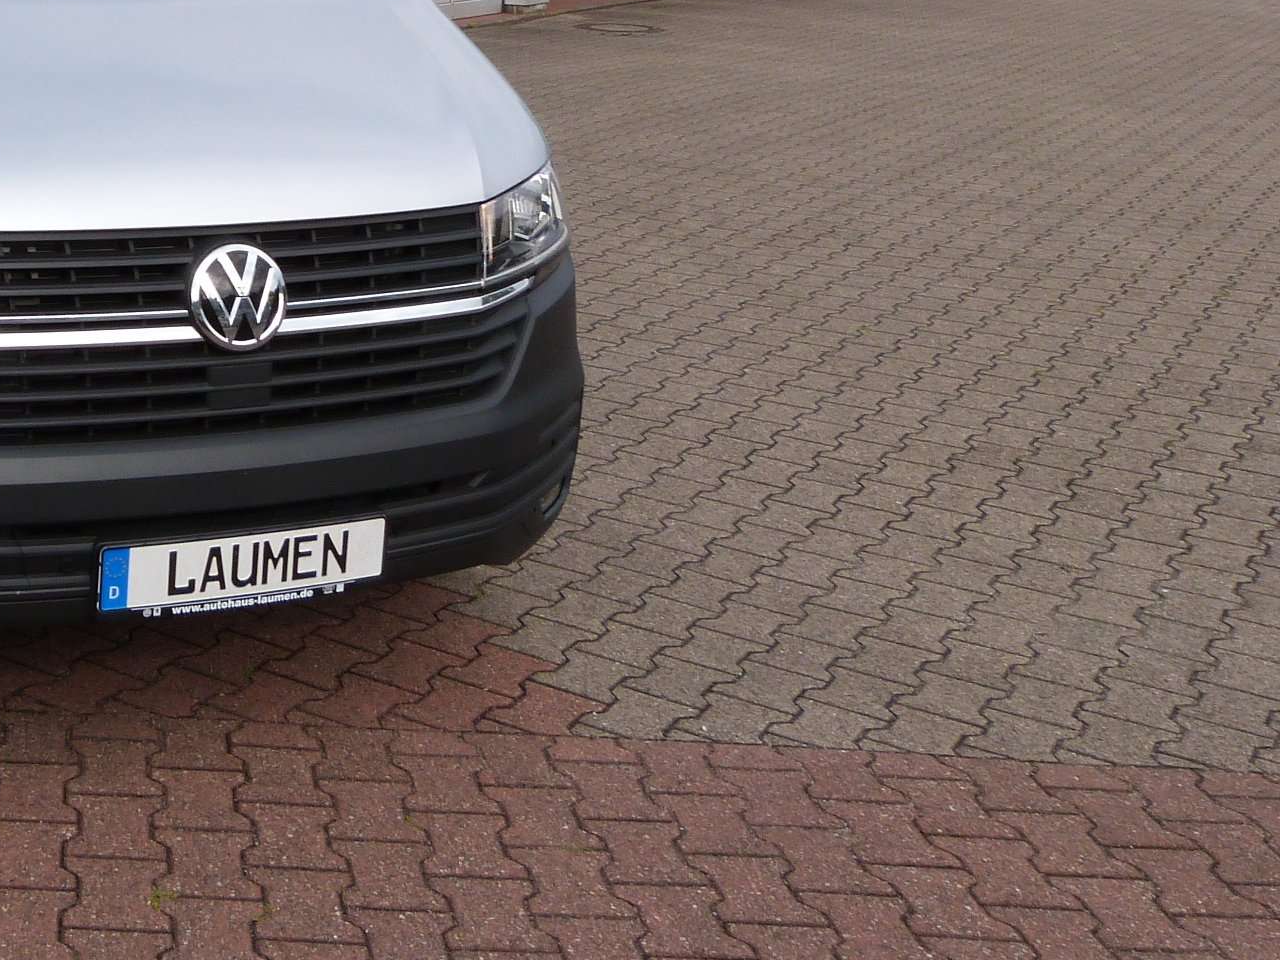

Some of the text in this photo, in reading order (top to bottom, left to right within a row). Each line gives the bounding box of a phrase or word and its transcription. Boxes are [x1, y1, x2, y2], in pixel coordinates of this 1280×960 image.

[108, 529, 349, 600] D LAUMEN
[171, 588, 314, 616] www.autohaus-laumen.de
